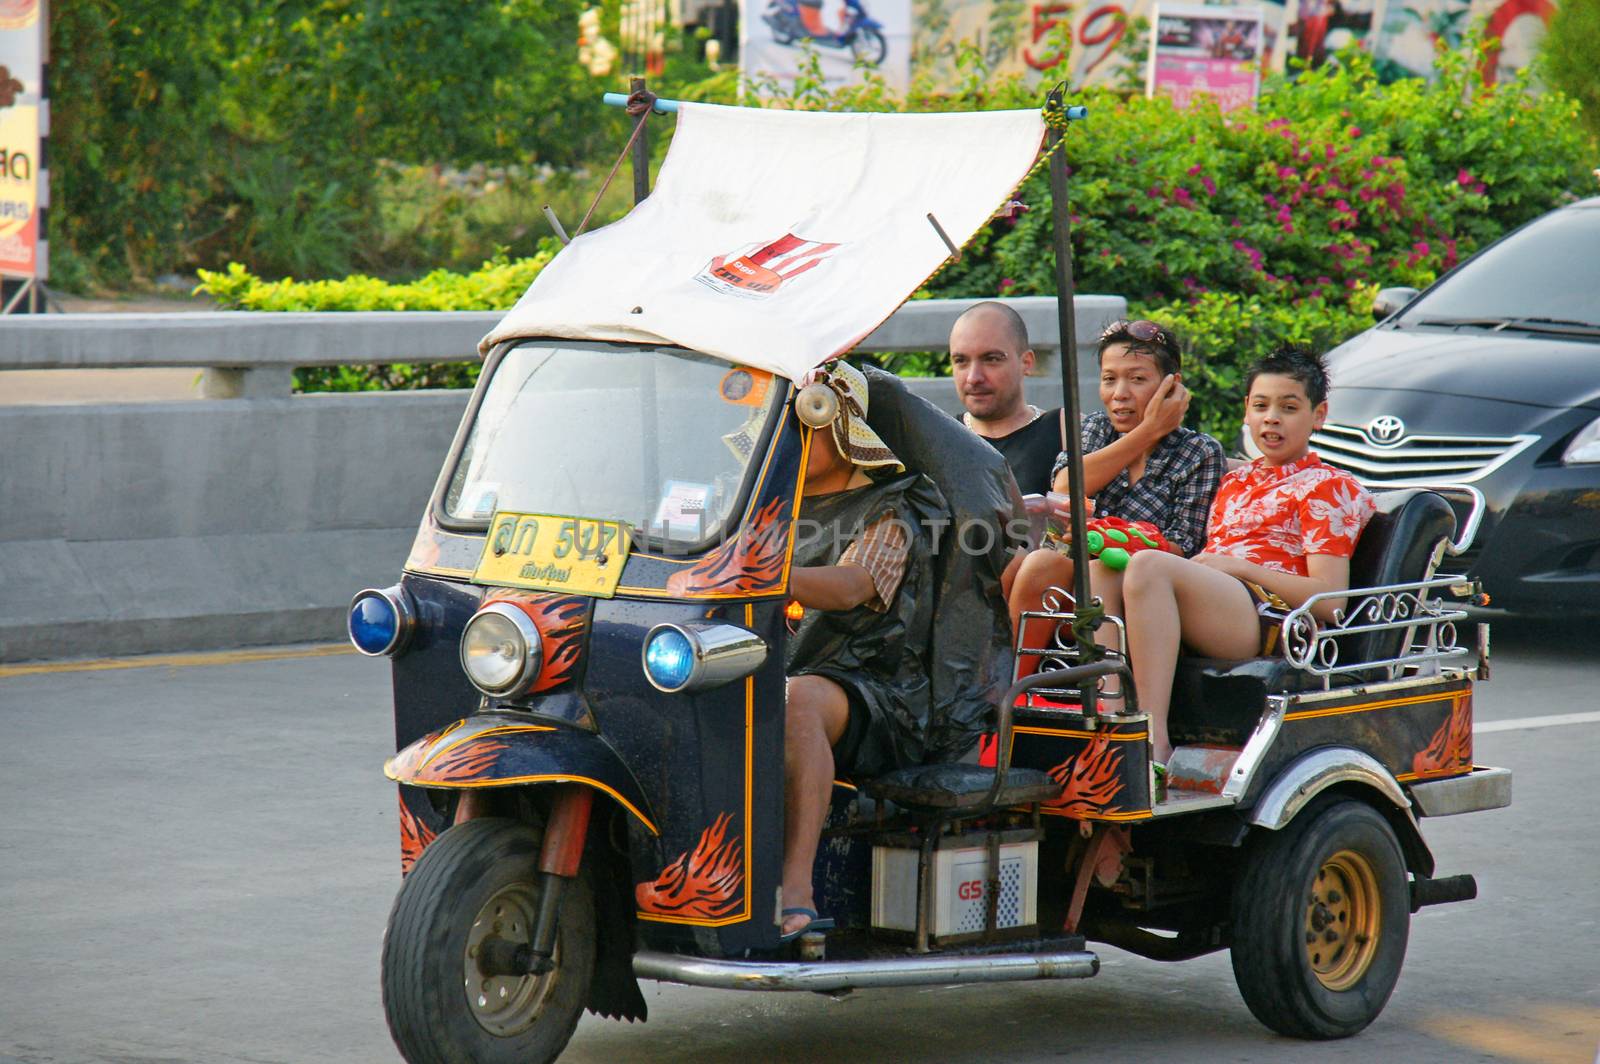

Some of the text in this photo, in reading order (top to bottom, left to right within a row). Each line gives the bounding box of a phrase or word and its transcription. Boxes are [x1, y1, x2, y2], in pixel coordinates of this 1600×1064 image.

[1023, 3, 1127, 75] 59
[554, 521, 616, 561] 517
[958, 880, 982, 900] GS
